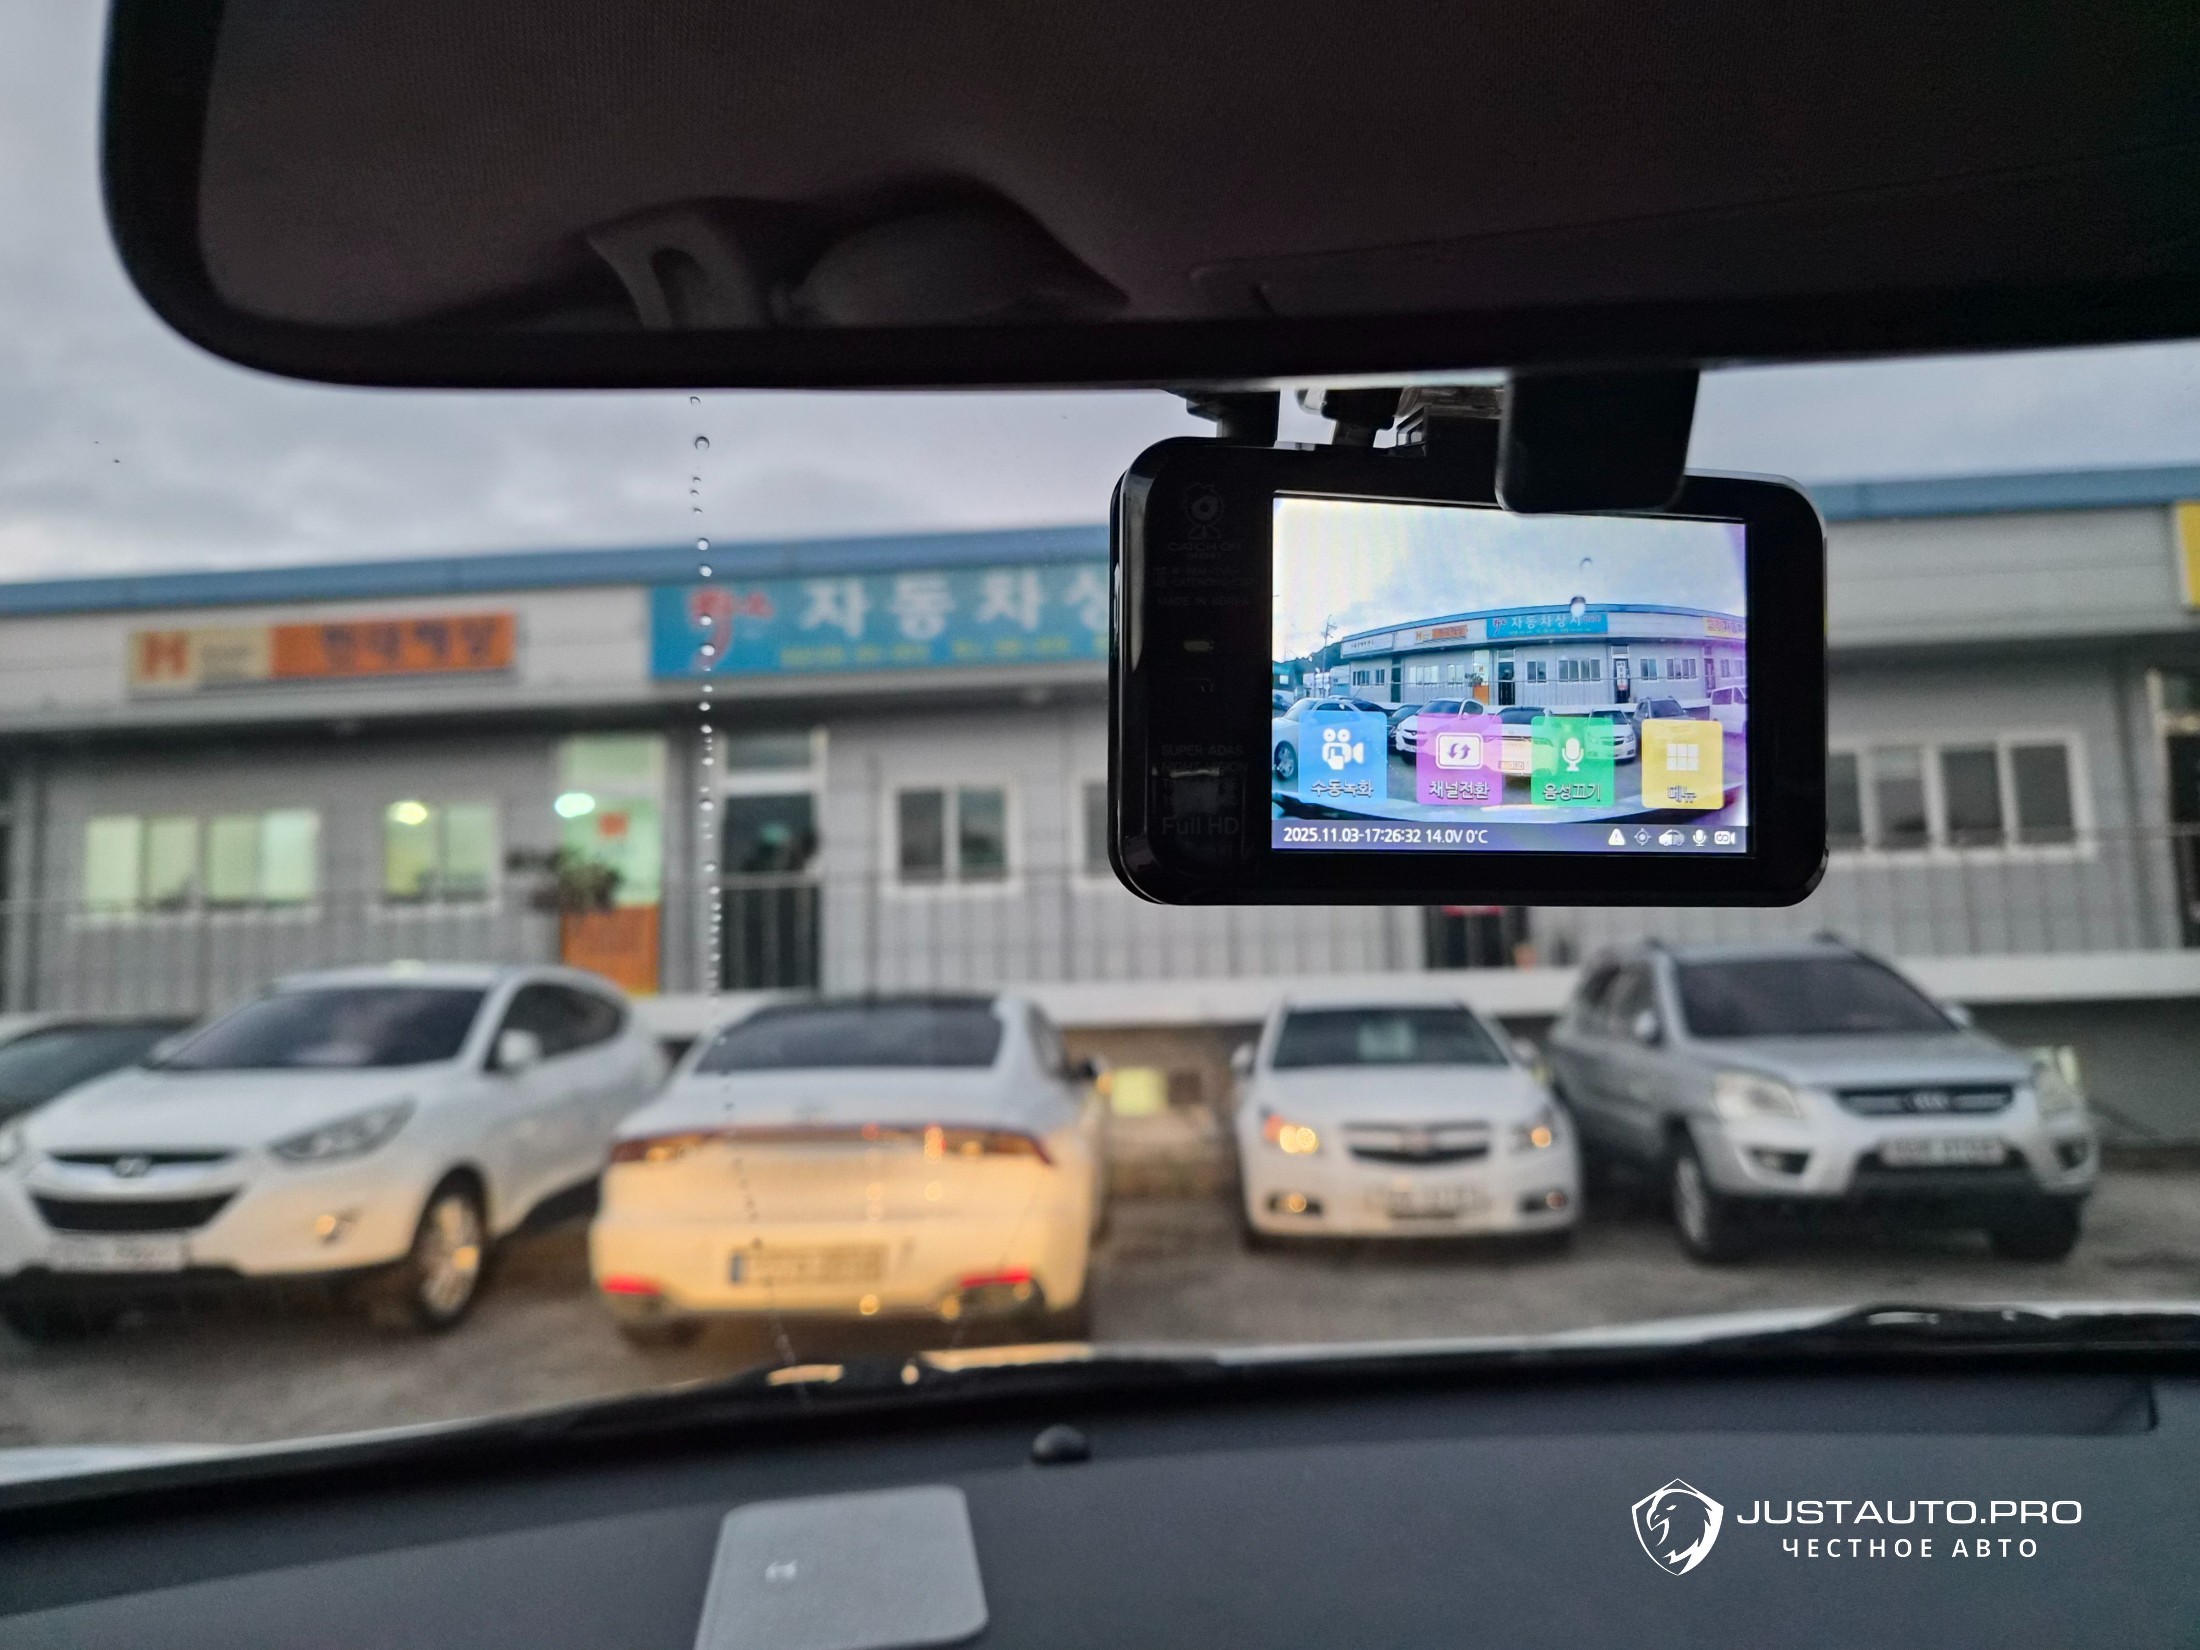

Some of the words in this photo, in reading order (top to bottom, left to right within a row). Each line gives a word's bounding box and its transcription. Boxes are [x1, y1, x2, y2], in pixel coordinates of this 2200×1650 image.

[1160, 744, 1203, 757] SUPER
[1208, 744, 1245, 757] ADAS
[1311, 780, 1374, 798] 수동녹화
[1429, 781, 1490, 800] 채널전환
[1543, 783, 1601, 801] 음성끄기
[1668, 785, 1697, 803] 메뉴
[1162, 816, 1200, 835] Full
[1207, 816, 1240, 835] HD
[1283, 827, 1421, 843] 2025.11.03-17:26:32
[1425, 828, 1463, 844] 14.0V
[1465, 829, 1488, 844] 0°C
